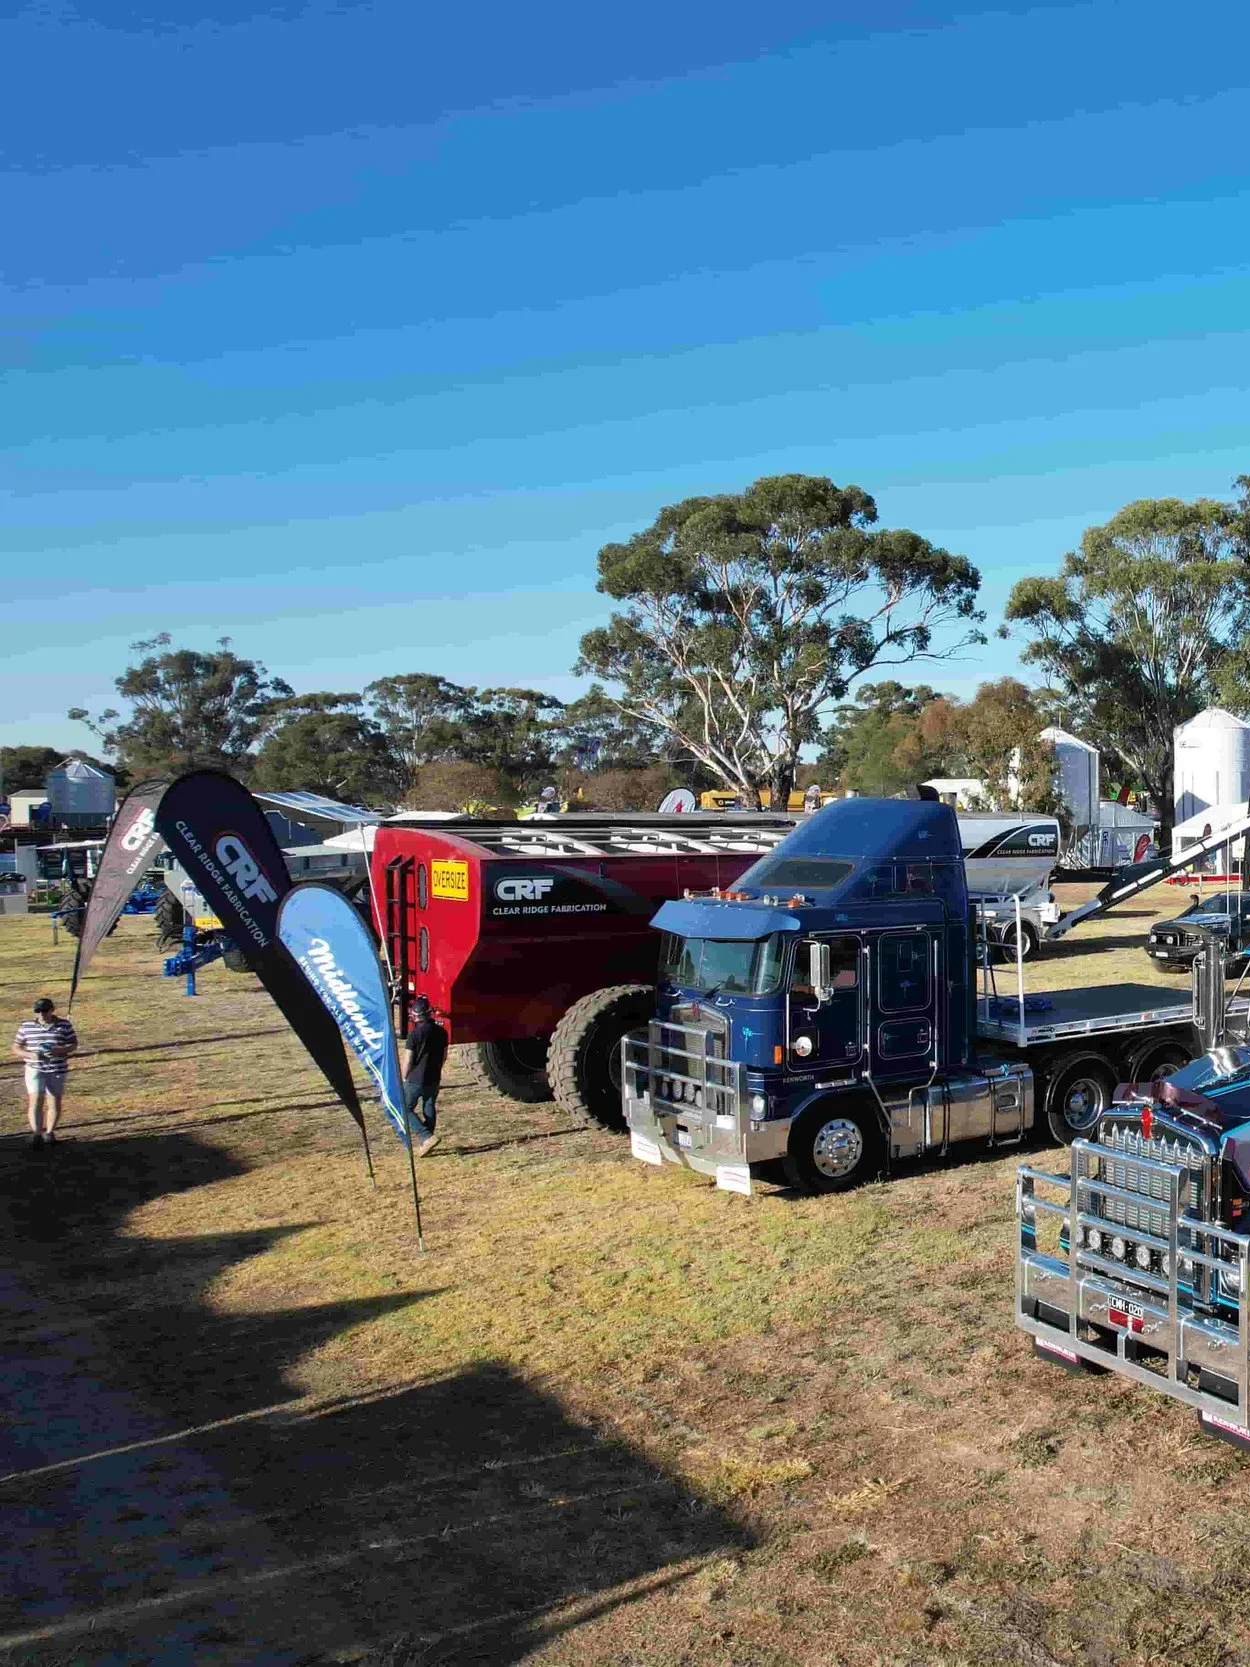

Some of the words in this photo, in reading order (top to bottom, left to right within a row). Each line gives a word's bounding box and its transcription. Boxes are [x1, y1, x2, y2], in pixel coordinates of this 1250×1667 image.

[1028, 833, 1057, 847] CRF
[215, 835, 279, 904] CRF
[433, 869, 467, 891] OVERSIZE
[175, 820, 203, 853] CLEAR
[199, 852, 223, 886] RIDGE
[221, 882, 270, 948] FABRICATION
[496, 878, 554, 901] CRF
[492, 907, 521, 916] CLEAR
[522, 906, 549, 915] RIDGE
[550, 904, 607, 914] FABRICATION
[307, 936, 385, 1050] Midland
